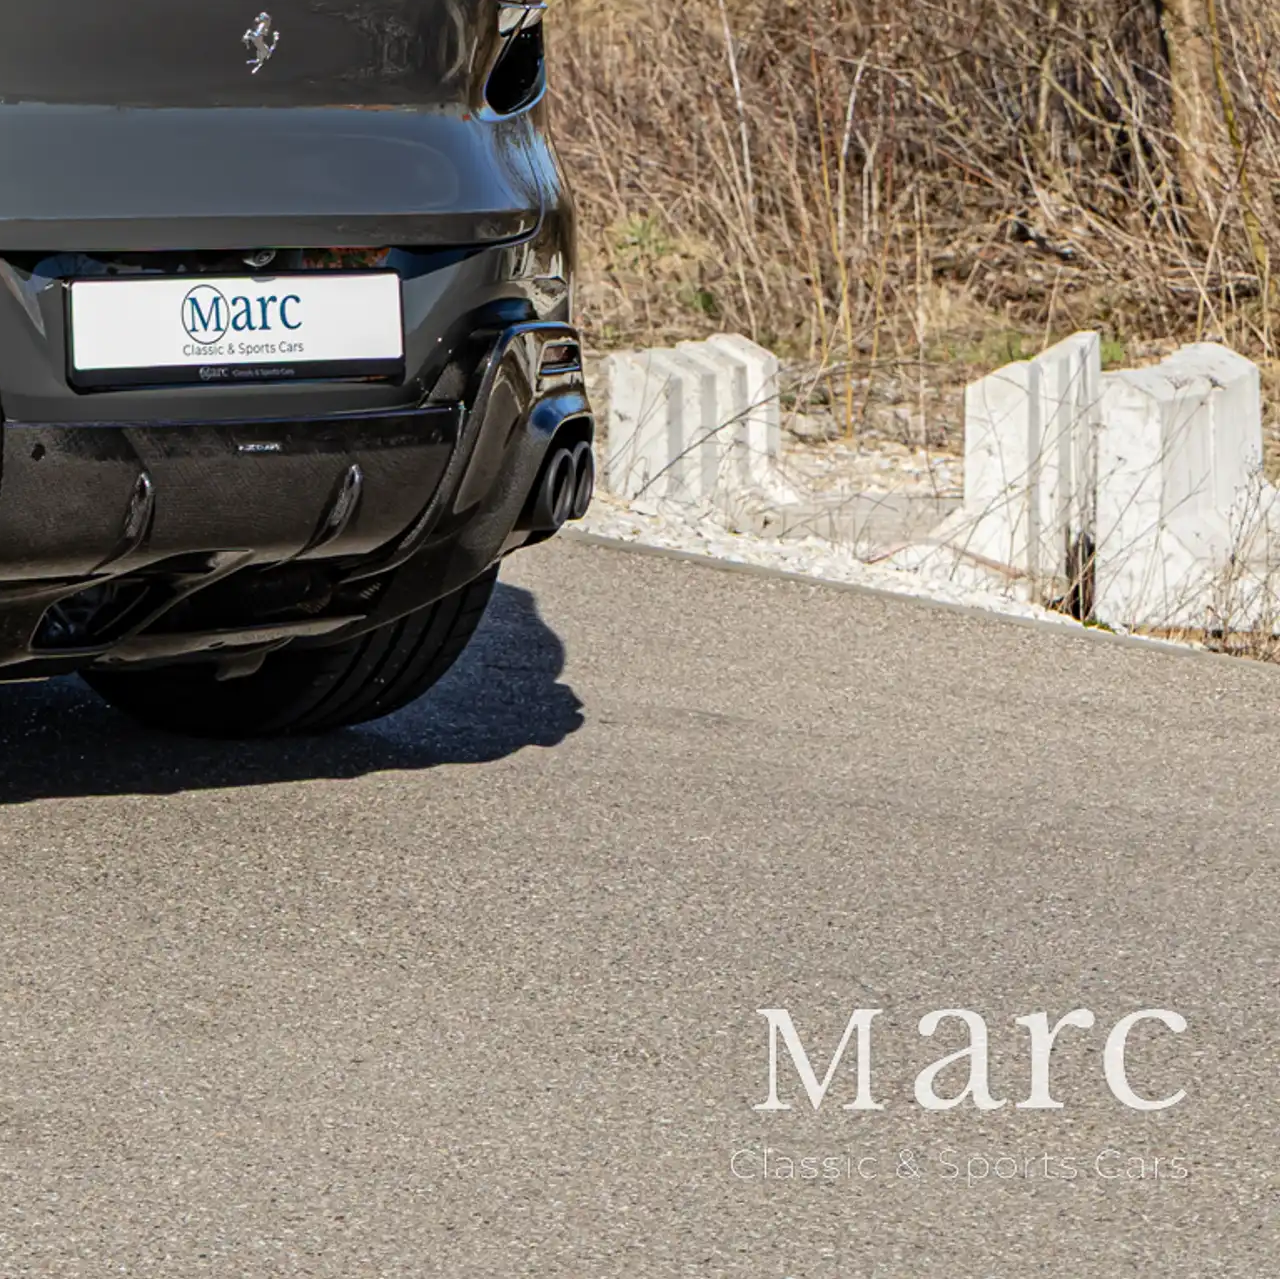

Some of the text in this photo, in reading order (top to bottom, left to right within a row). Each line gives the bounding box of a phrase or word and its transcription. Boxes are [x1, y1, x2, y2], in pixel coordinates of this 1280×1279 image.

[186, 293, 303, 332] Marc
[182, 341, 305, 357] Classic & Sports Cars
